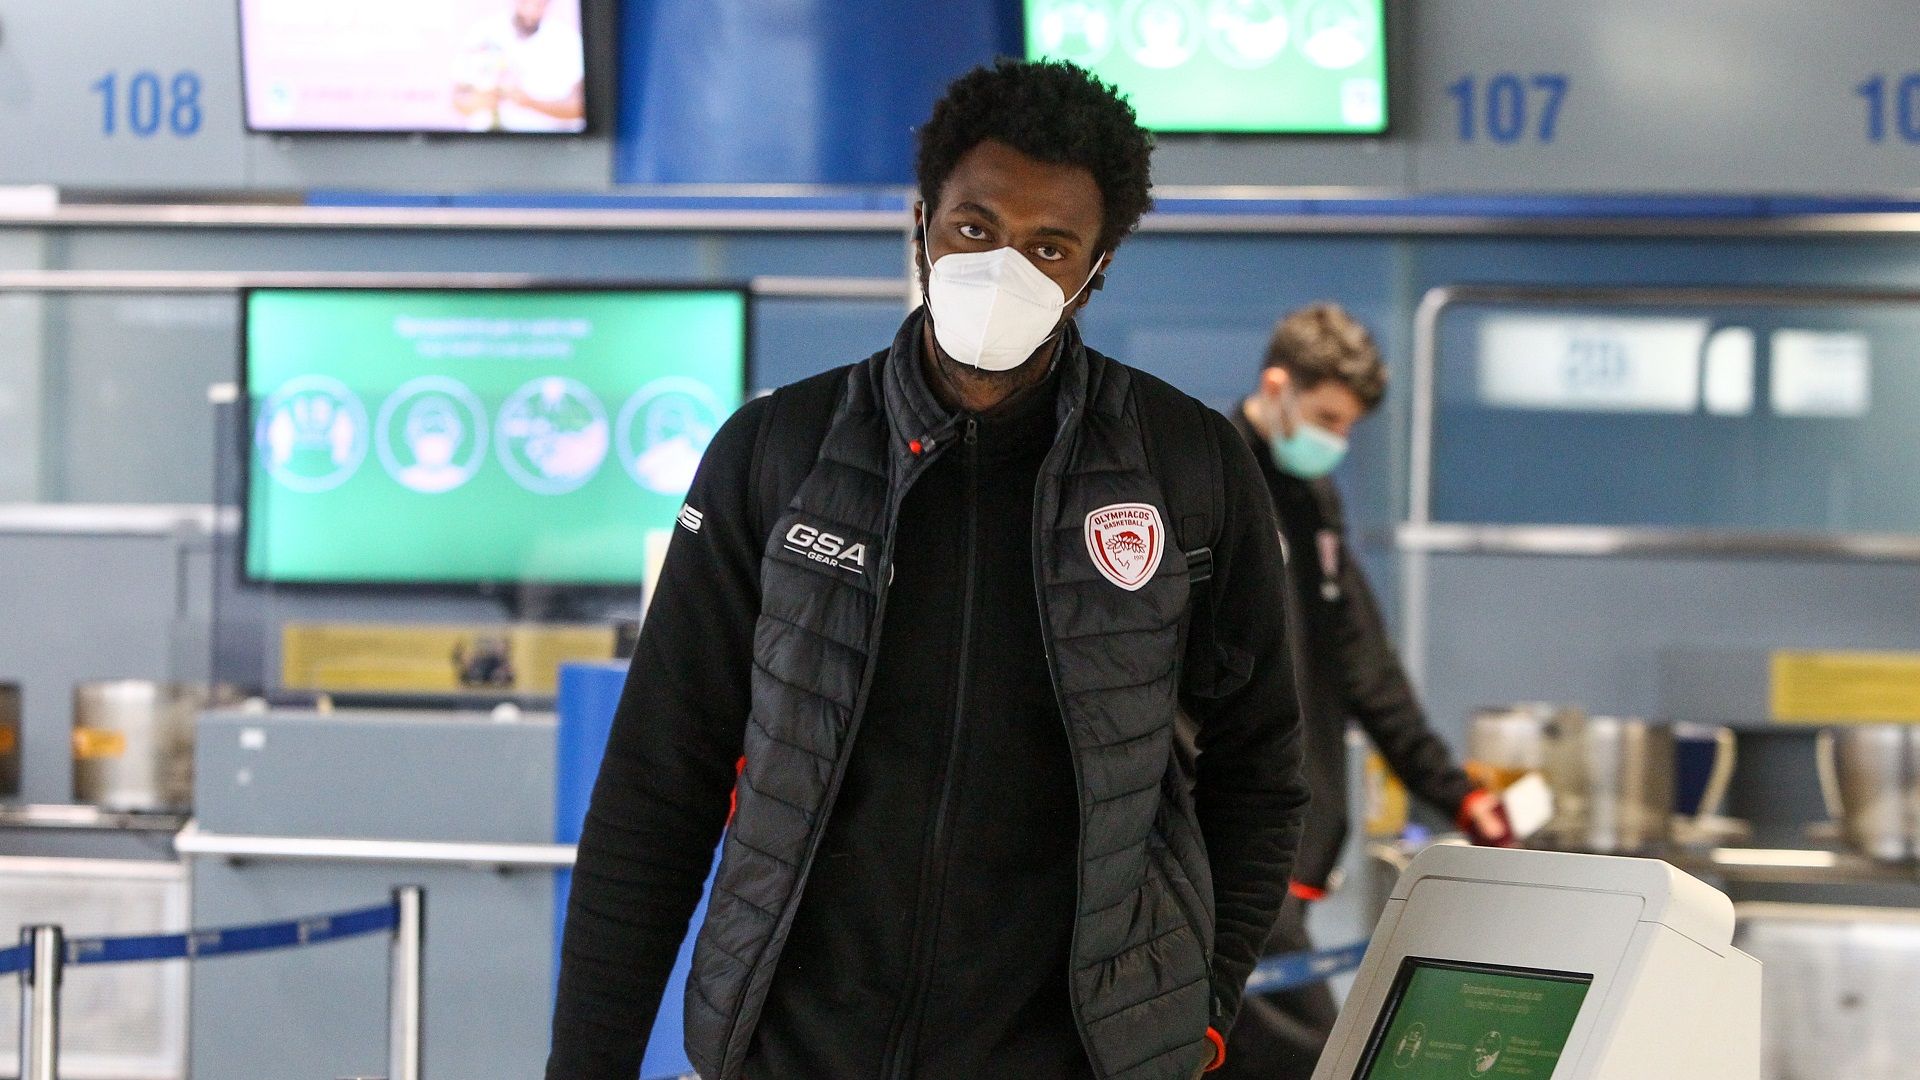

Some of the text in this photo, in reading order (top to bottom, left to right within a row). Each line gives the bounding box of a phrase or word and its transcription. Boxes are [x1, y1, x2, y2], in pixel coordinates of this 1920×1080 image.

[91, 71, 203, 137] 108
[1447, 74, 1569, 144] 107
[1095, 511, 1149, 524] OLYMPIACOS
[1103, 520, 1144, 529] BASKETBALL
[786, 523, 866, 566] GSA
[807, 551, 838, 567] GEAR
